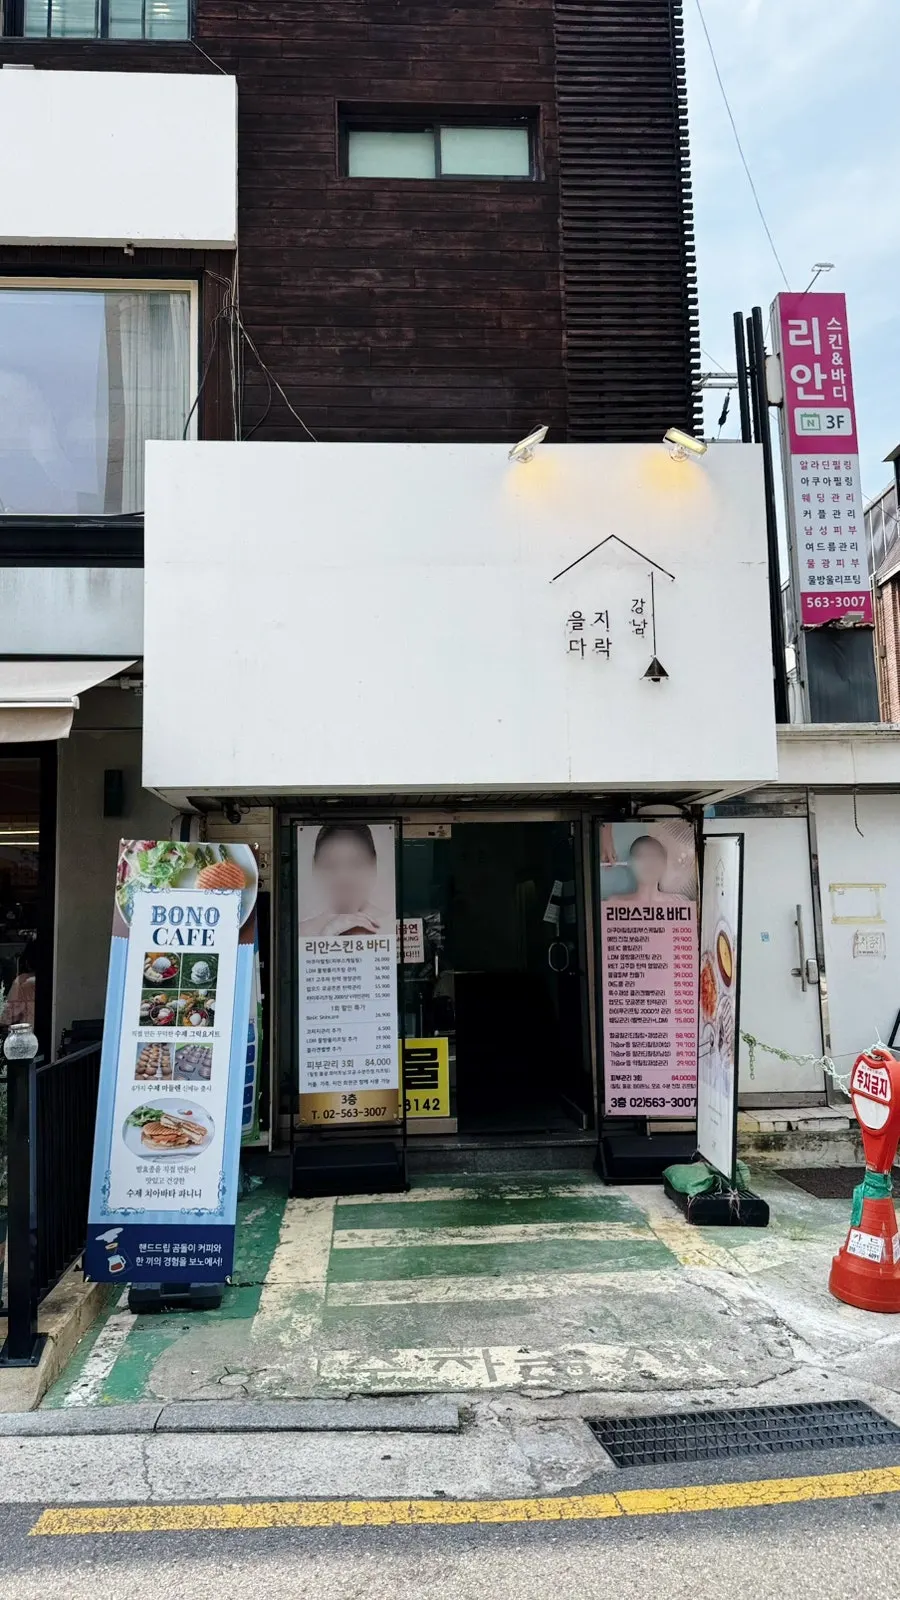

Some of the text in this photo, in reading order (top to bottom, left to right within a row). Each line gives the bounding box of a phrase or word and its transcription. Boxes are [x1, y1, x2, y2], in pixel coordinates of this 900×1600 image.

[787, 317, 828, 401] 리안
[826, 317, 847, 402] 스킨&바디
[826, 415, 845, 429] 3F
[800, 460, 852, 471] 알라딘필링
[800, 476, 853, 487] 아쿠아필링
[805, 542, 858, 552] 여드름관리
[808, 575, 861, 586] 물방울리프팅
[806, 596, 866, 608] 563-3007
[631, 598, 648, 635] 강남
[150, 905, 220, 926] BONO
[606, 907, 691, 921] 리안스킨&바디
[152, 927, 215, 947] CAFE
[175, 1030, 188, 1038] 수제
[306, 1059, 339, 1069] 피부관리
[341, 1059, 354, 1068] 3회
[147, 1084, 160, 1092] 수제
[161, 1084, 181, 1092] 마들렌
[857, 1069, 888, 1098] 주차금지
[341, 1094, 357, 1105] 3층
[610, 1097, 697, 1108] 3층 02)563-3007
[311, 1107, 387, 1119] T. 02-563-3007
[162, 1165, 176, 1173] 직접
[177, 1165, 196, 1173] 만들어
[166, 1177, 185, 1185] 건강한
[126, 1188, 202, 1198] 수제 치아바타 파니니
[139, 1243, 171, 1253] 핸드드립
[197, 1243, 222, 1253] 커피와
[136, 1257, 144, 1267] 한
[163, 1257, 187, 1267] 경험을
[188, 1257, 223, 1267] 보노에서!
